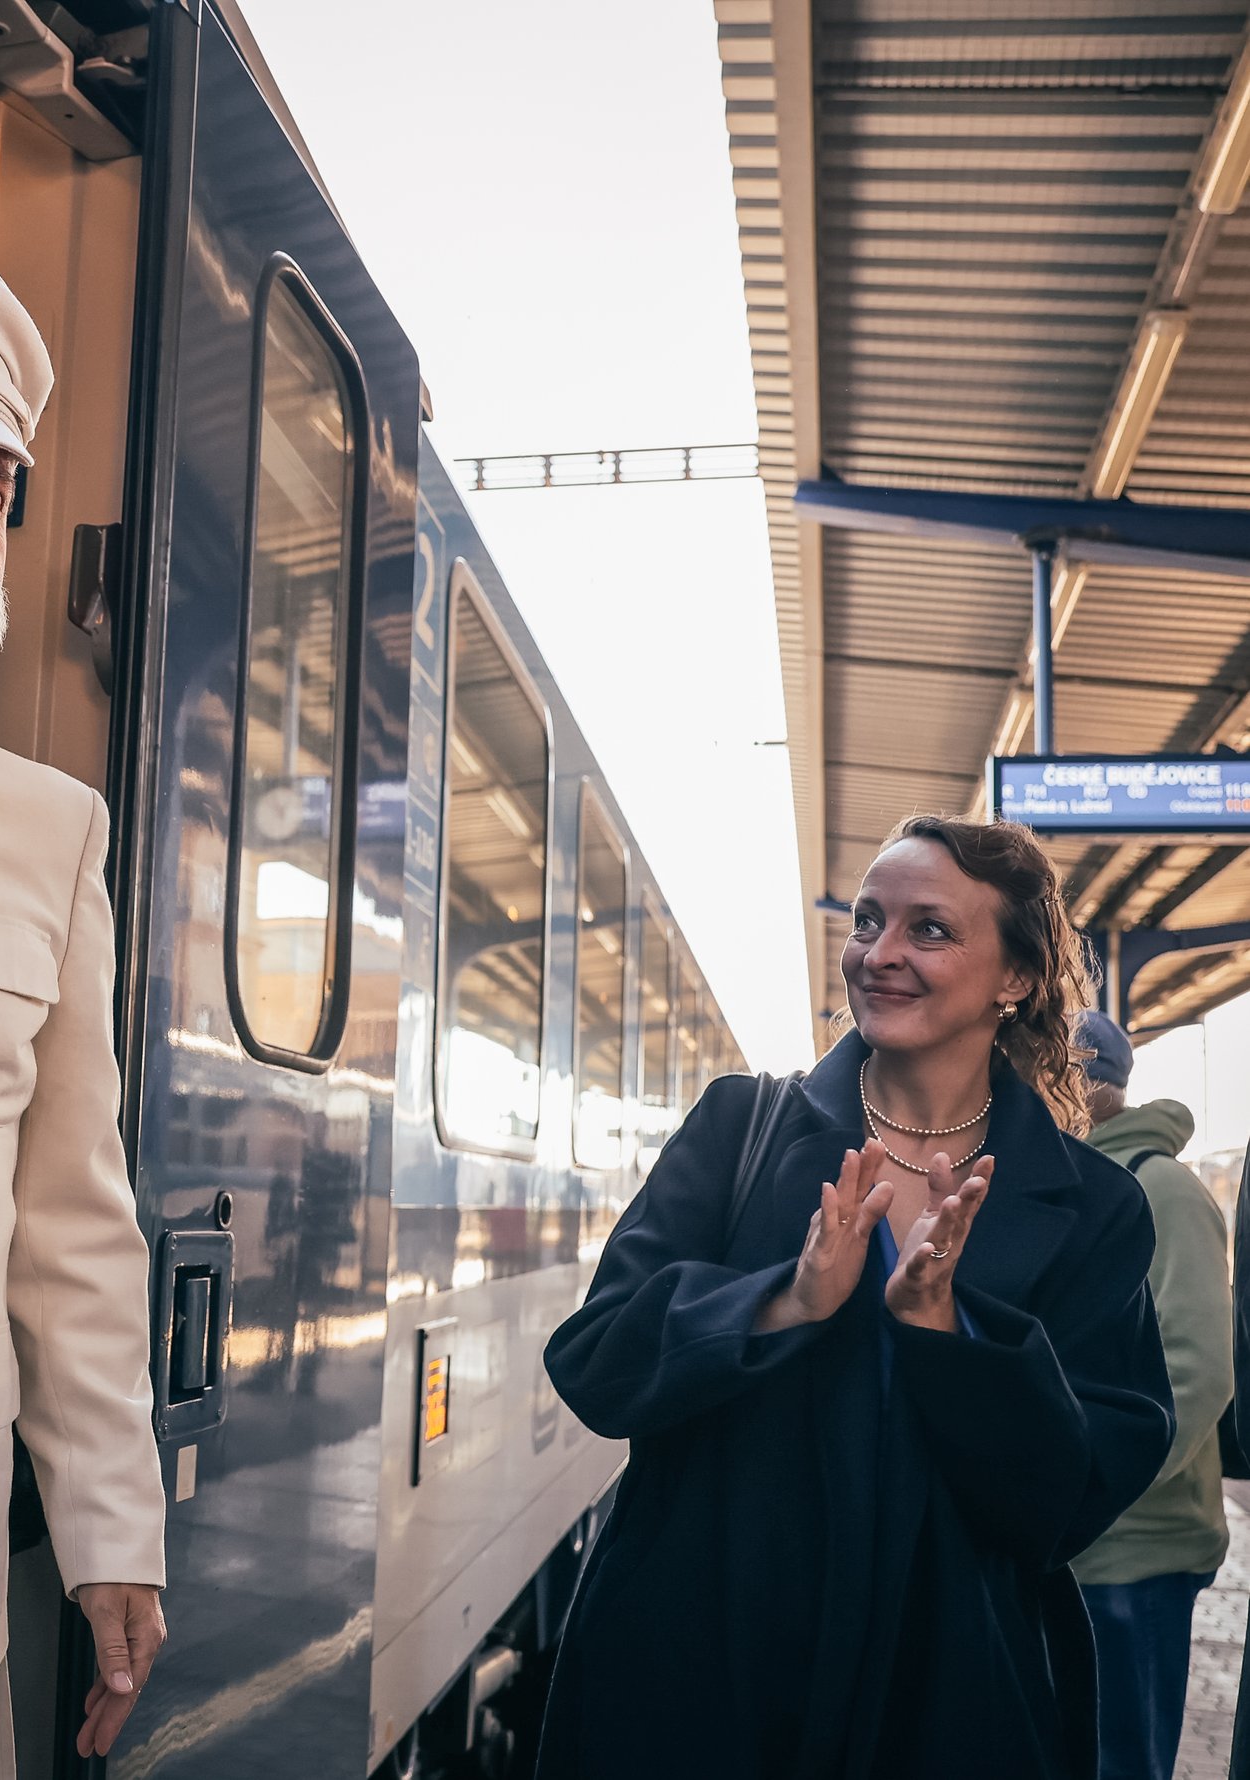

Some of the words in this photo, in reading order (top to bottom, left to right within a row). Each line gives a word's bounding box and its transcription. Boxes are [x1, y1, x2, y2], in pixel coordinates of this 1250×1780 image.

[414, 531, 435, 650] 2
[1043, 763, 1104, 786] ČESKÉ
[1106, 762, 1221, 786] BUDĚJOVICE
